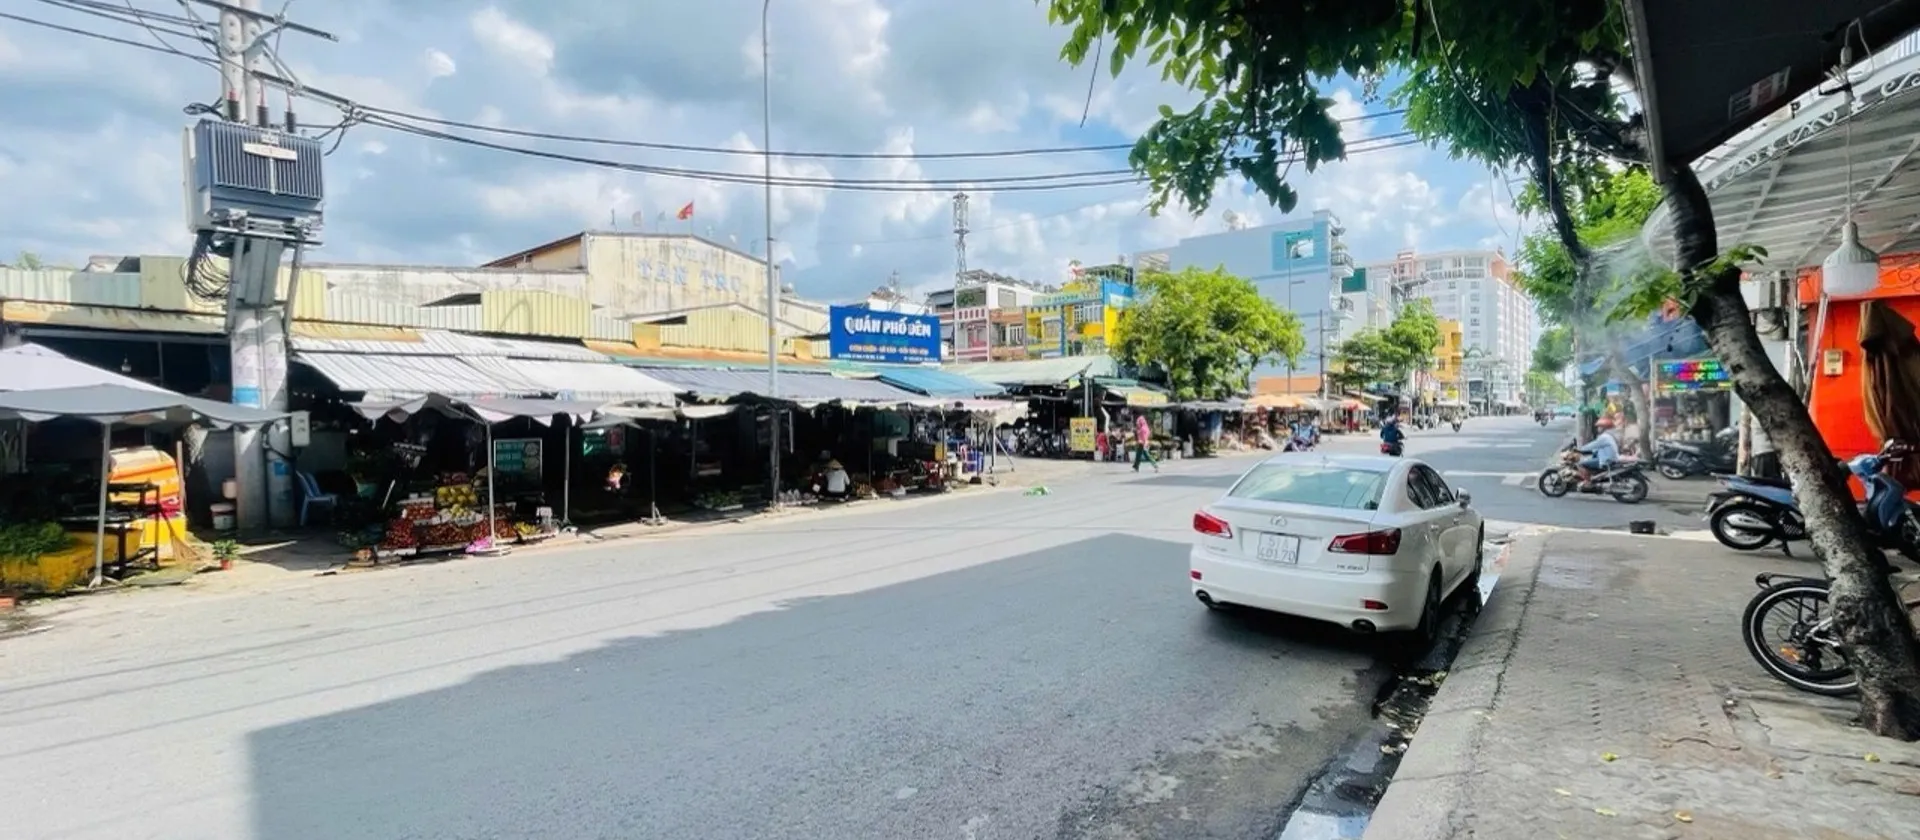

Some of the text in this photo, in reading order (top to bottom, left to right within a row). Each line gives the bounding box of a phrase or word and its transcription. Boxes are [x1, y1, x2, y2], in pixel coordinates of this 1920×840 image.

[844, 314, 881, 334] QUÁN
[882, 316, 908, 336] PHỐ
[1269, 536, 1289, 549] 51A
